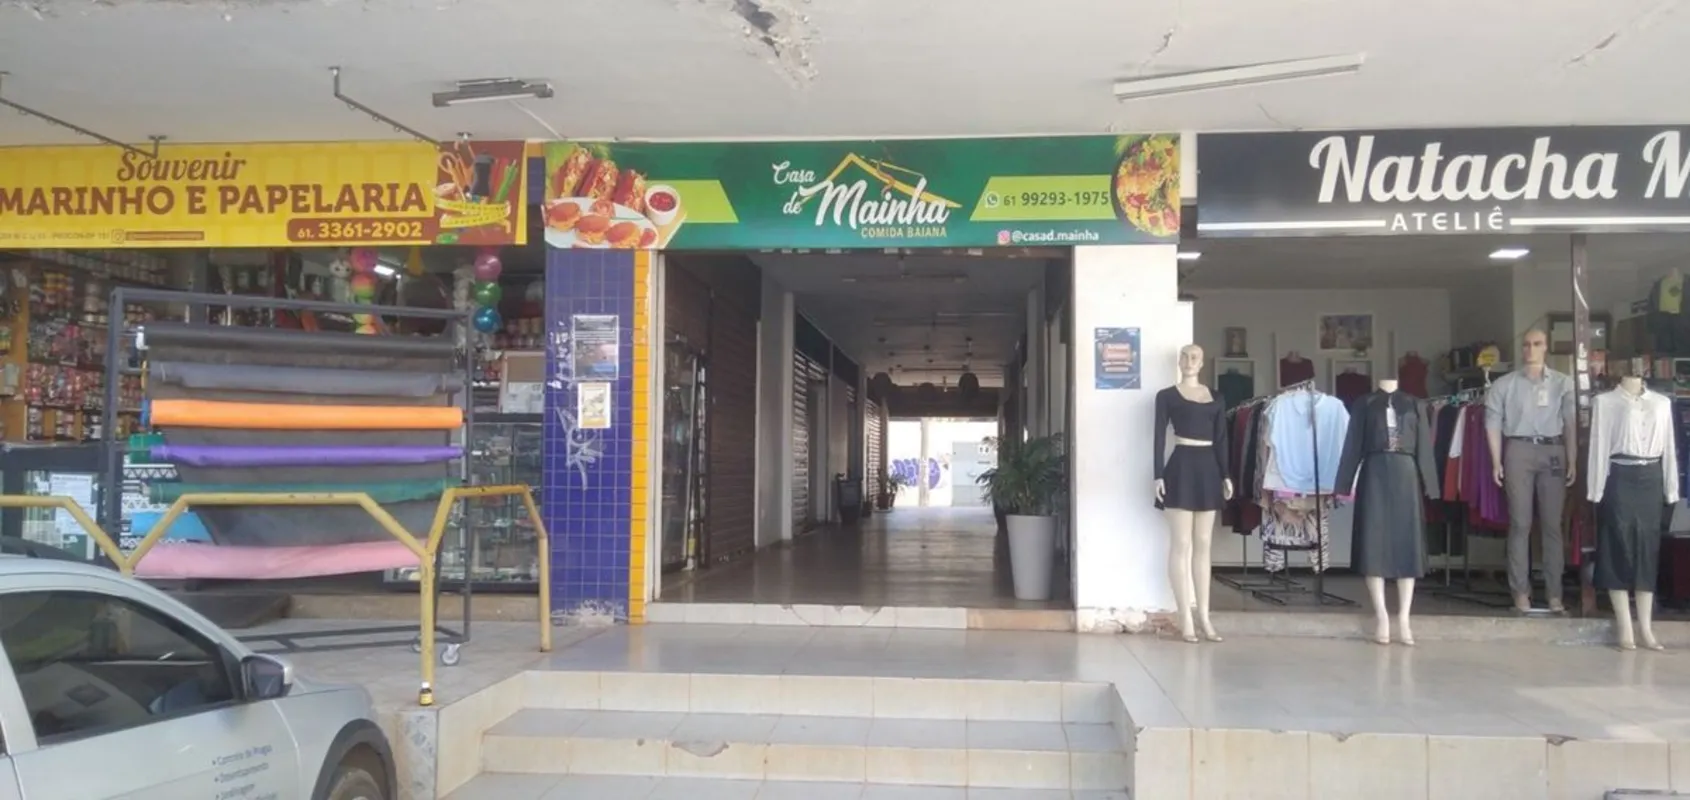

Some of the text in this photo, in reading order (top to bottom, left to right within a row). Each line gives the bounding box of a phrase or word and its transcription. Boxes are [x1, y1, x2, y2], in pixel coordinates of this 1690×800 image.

[117, 151, 246, 181] Souvenir
[772, 160, 815, 184] Casa
[1309, 135, 1618, 203] Natacha
[0, 182, 428, 215] MARINHO E PAPELARIA
[783, 177, 949, 229] de Mainha
[1003, 191, 1109, 206] 61 99293-1975
[297, 221, 422, 239] 61. 3361-2902
[1391, 205, 1503, 232] ATELIÊ
[861, 227, 948, 238] COMIDA BAIANA
[1012, 228, 1099, 243] @casad.mainha
